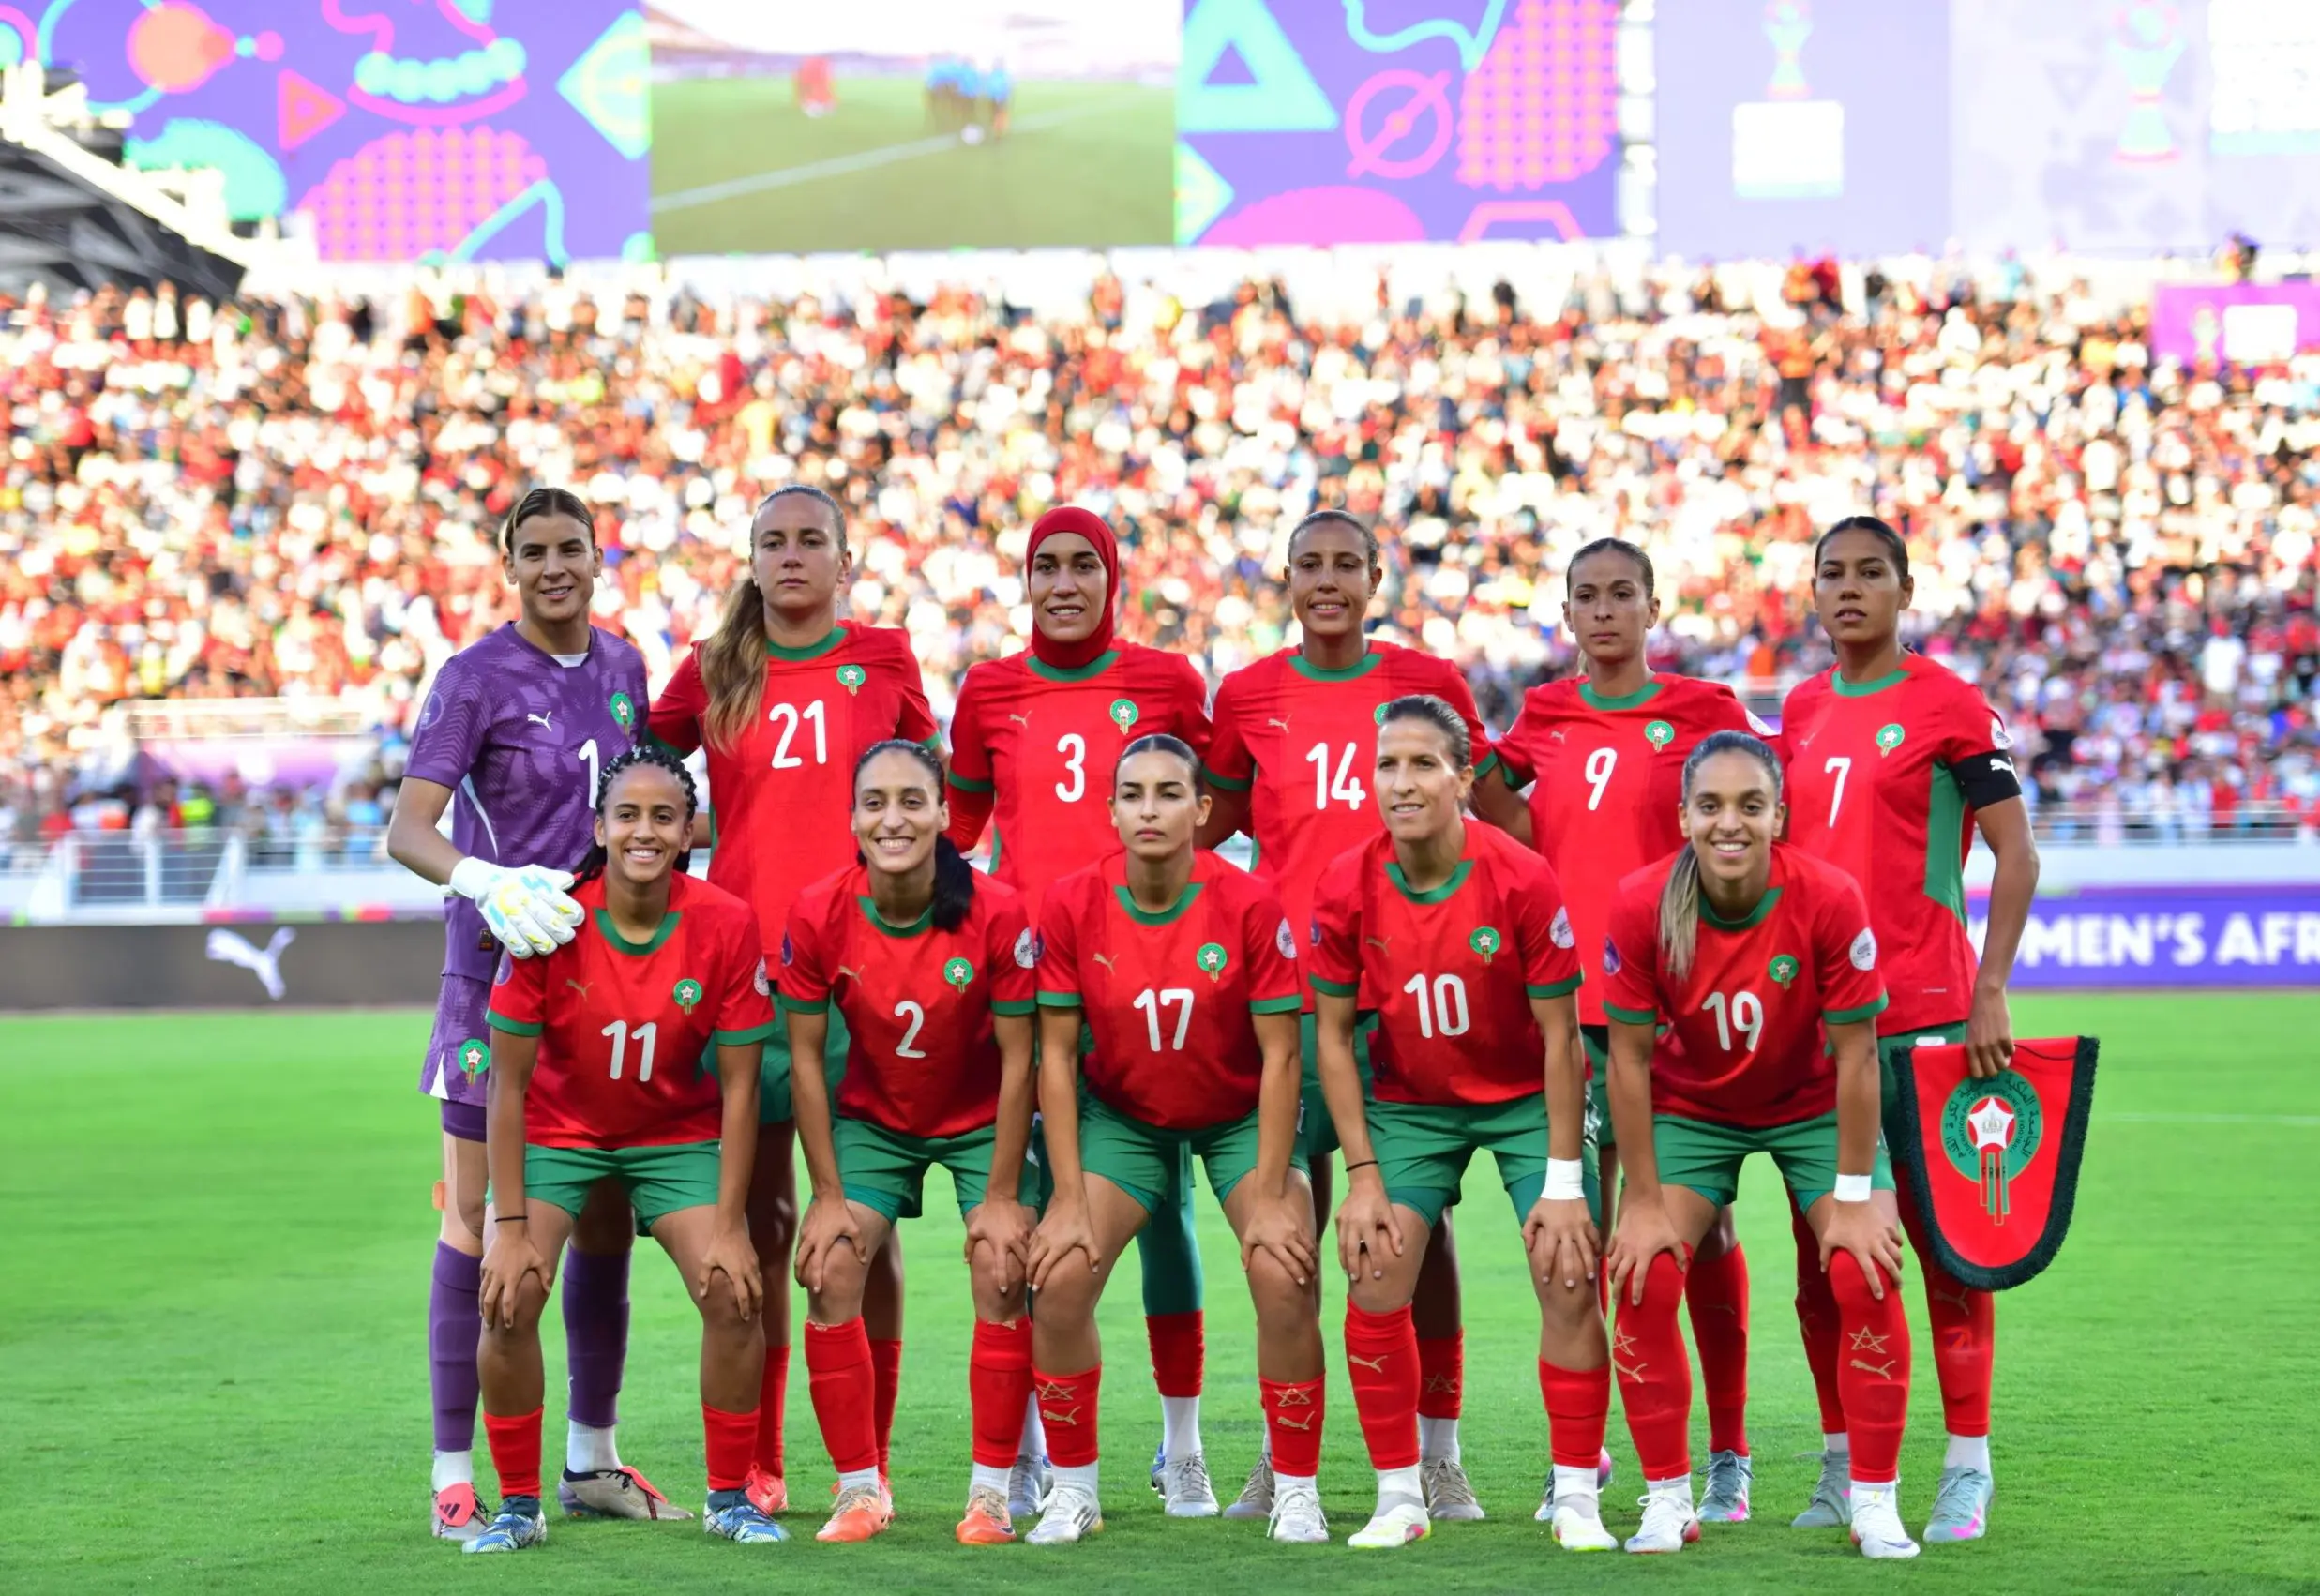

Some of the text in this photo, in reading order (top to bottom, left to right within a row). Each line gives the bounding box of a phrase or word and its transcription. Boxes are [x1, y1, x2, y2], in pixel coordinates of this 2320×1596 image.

[769, 700, 826, 769] 21
[578, 739, 599, 809] 1
[1056, 733, 1085, 802] 3
[1306, 742, 1366, 810] 14
[1585, 747, 1617, 811] 9
[1825, 758, 1851, 827] 7
[1967, 913, 2205, 967] MEN'S
[895, 1001, 925, 1059] 2
[1134, 988, 1194, 1051] 17
[1404, 973, 1469, 1038] 10
[1703, 991, 1764, 1051] 19
[602, 1020, 656, 1081] 11
